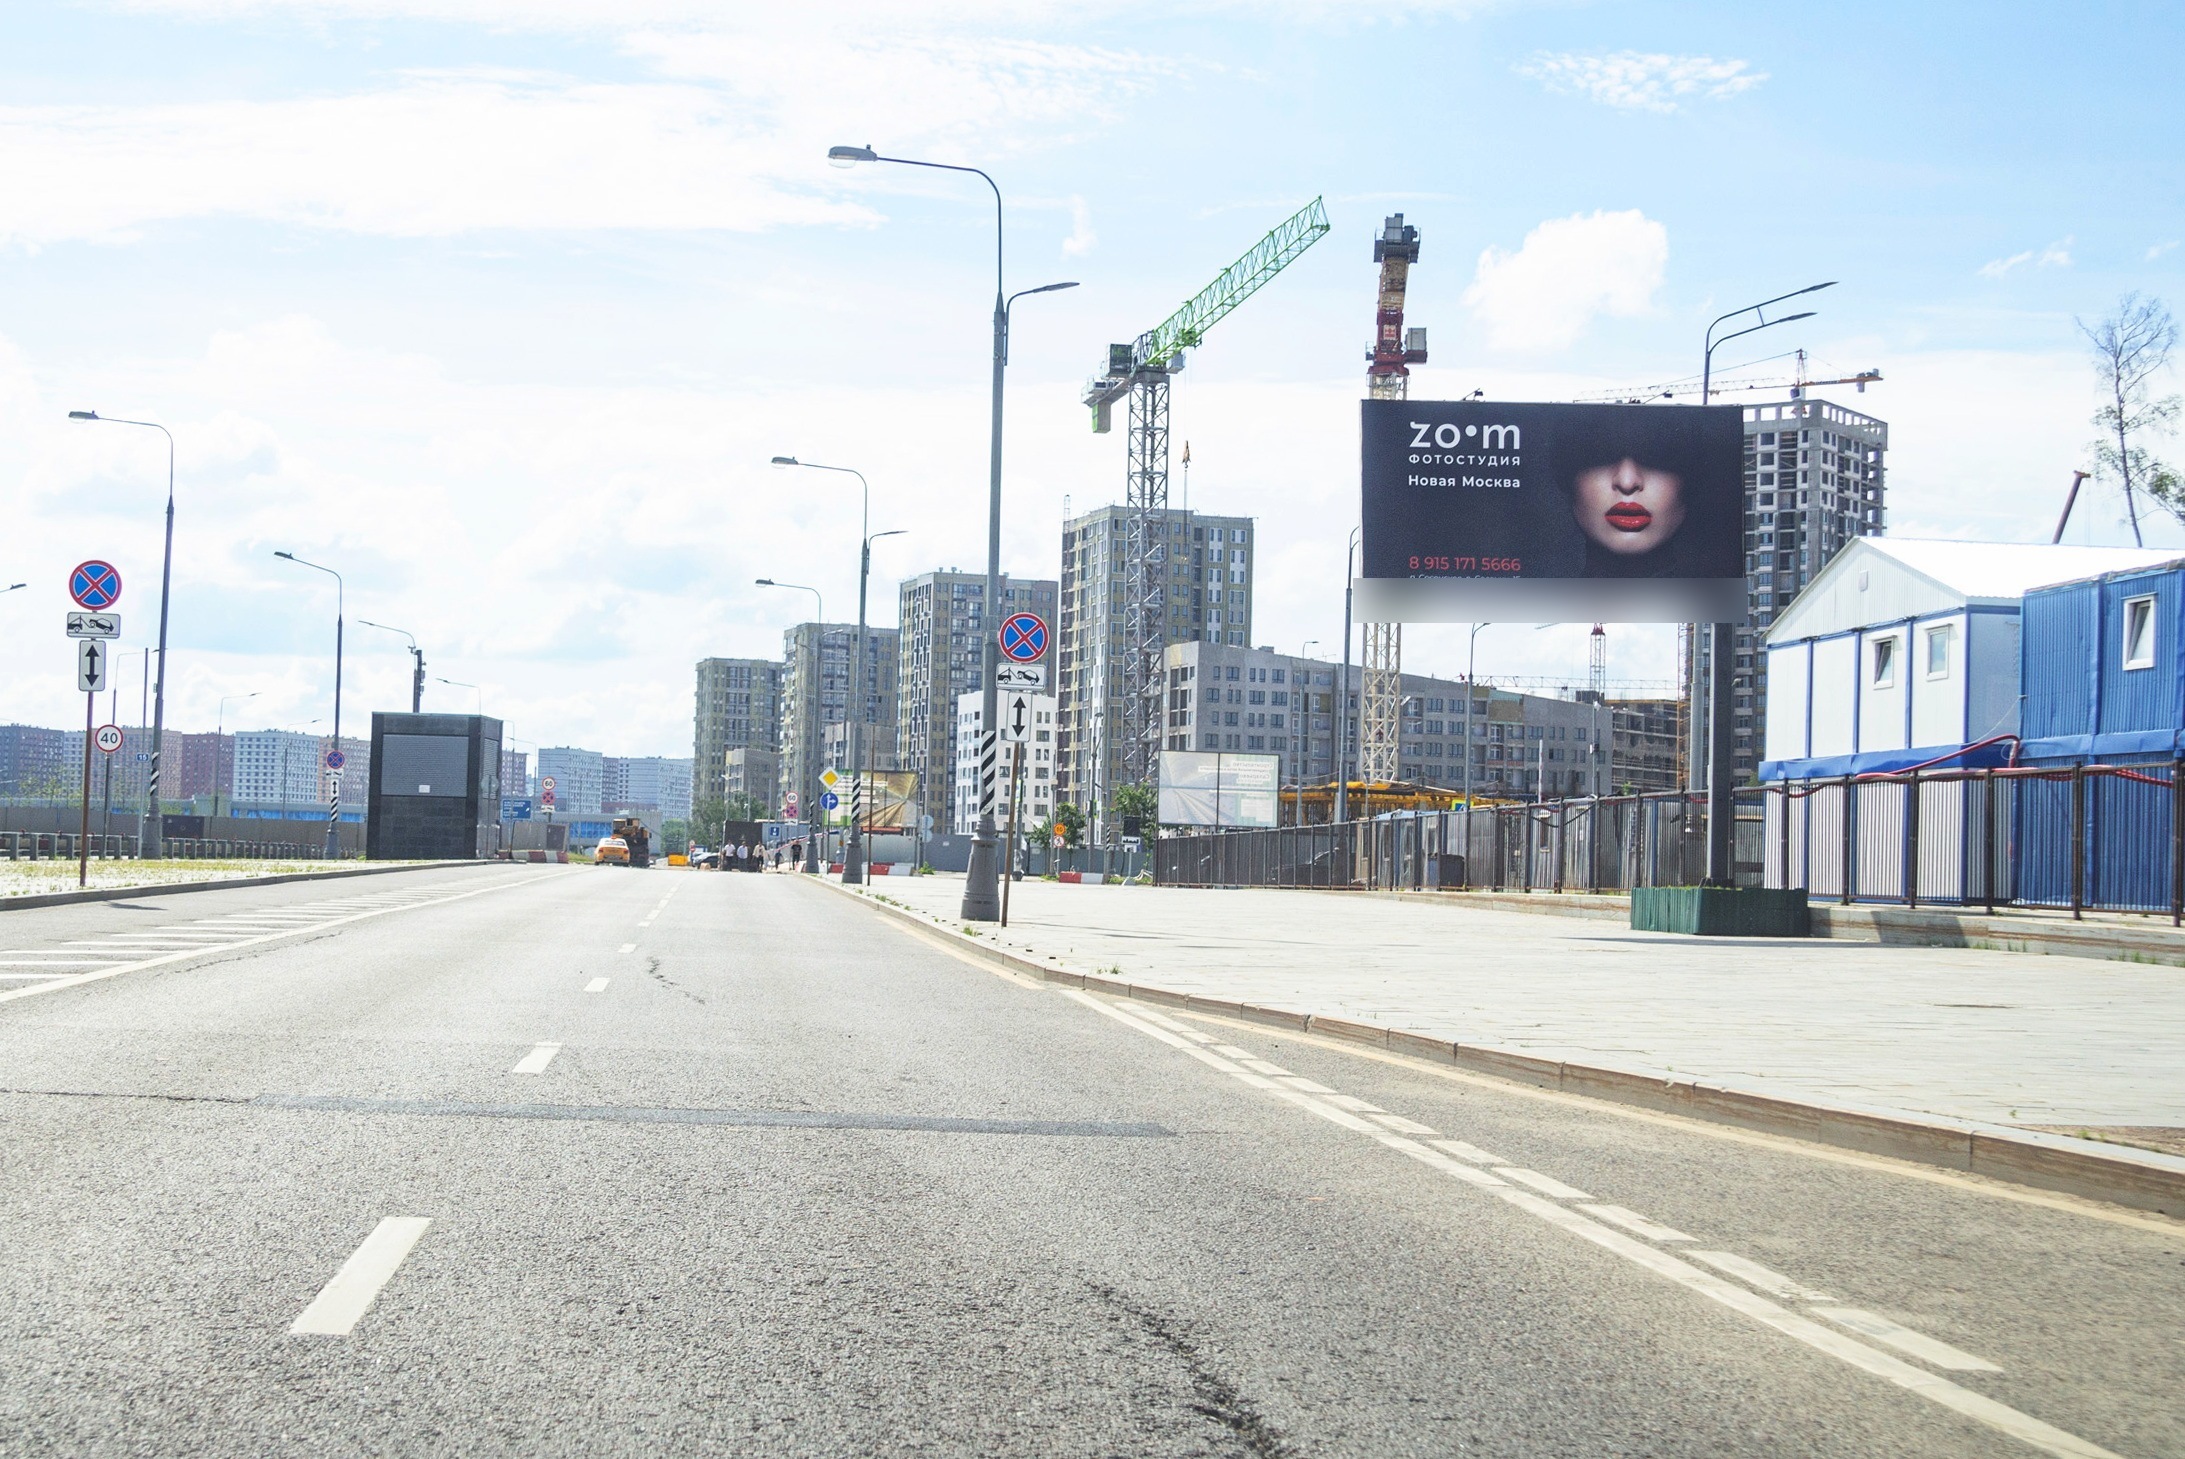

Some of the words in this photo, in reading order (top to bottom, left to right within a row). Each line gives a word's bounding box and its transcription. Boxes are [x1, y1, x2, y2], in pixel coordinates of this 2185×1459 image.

[1408, 454, 1520, 467] ФОТОСТУДИЯ
[1408, 474, 1456, 486] Новая
[1462, 476, 1521, 488] Москва
[1409, 556, 1419, 570] 8
[1424, 556, 1449, 570] 915
[1454, 557, 1476, 570] 171
[1481, 557, 1521, 571] 5666
[100, 732, 118, 744] 40
